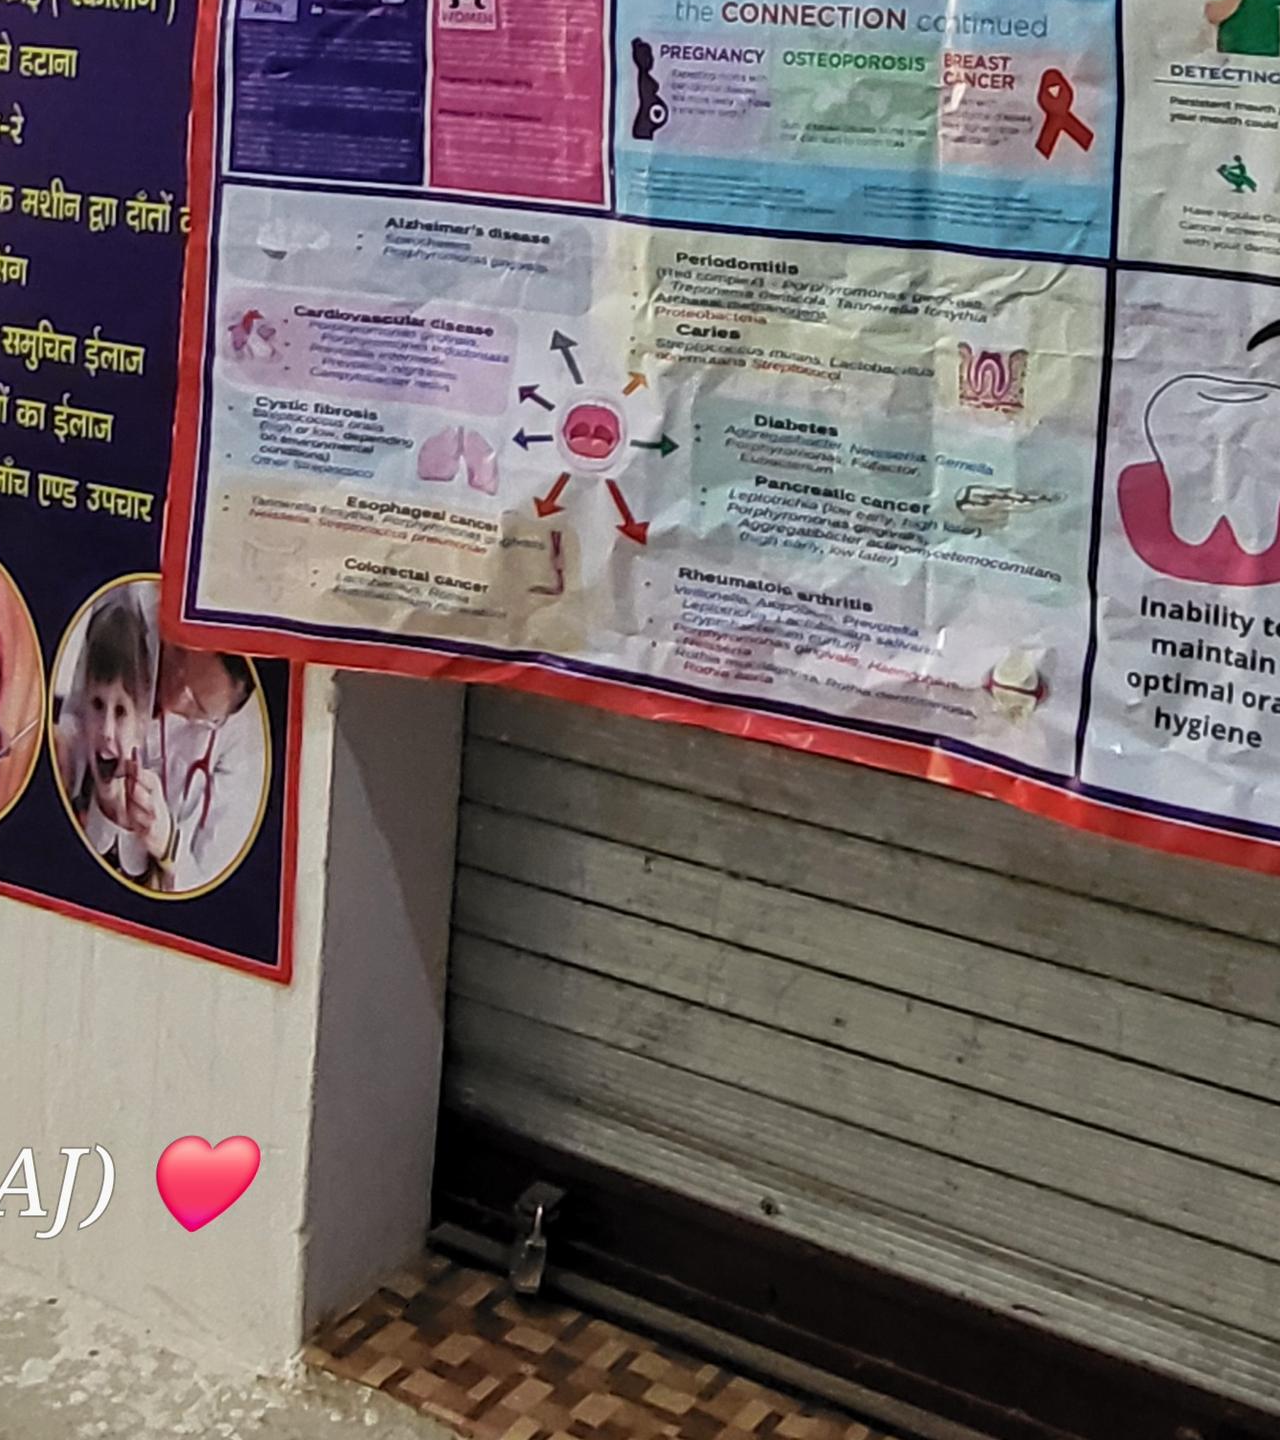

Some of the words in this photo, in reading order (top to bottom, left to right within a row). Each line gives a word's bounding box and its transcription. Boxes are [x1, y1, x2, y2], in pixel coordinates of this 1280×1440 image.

[675, 0, 714, 23] the
[722, 2, 907, 31] CONNECTION
[916, 14, 1048, 38] continued
[660, 44, 765, 64] PREGNANCY
[782, 51, 927, 72] OSTEOPOROSIS
[943, 53, 1012, 71] BREAST
[943, 72, 1015, 90] CANCER
[385, 216, 485, 238] Alzheimer's
[489, 224, 551, 245] disease
[676, 251, 800, 276] Periodontitis
[293, 305, 426, 327] Cardiovascular
[430, 315, 495, 337] disease
[676, 324, 742, 341] Caries
[16, 399, 45, 429] का
[753, 413, 839, 437] Diabetes
[754, 476, 856, 505] Pancreatic
[860, 497, 931, 515] cancer
[1139, 595, 1255, 639] Inability
[1150, 633, 1277, 675] maintain
[1125, 666, 1236, 711] optimal
[1152, 706, 1263, 750] hygiene
